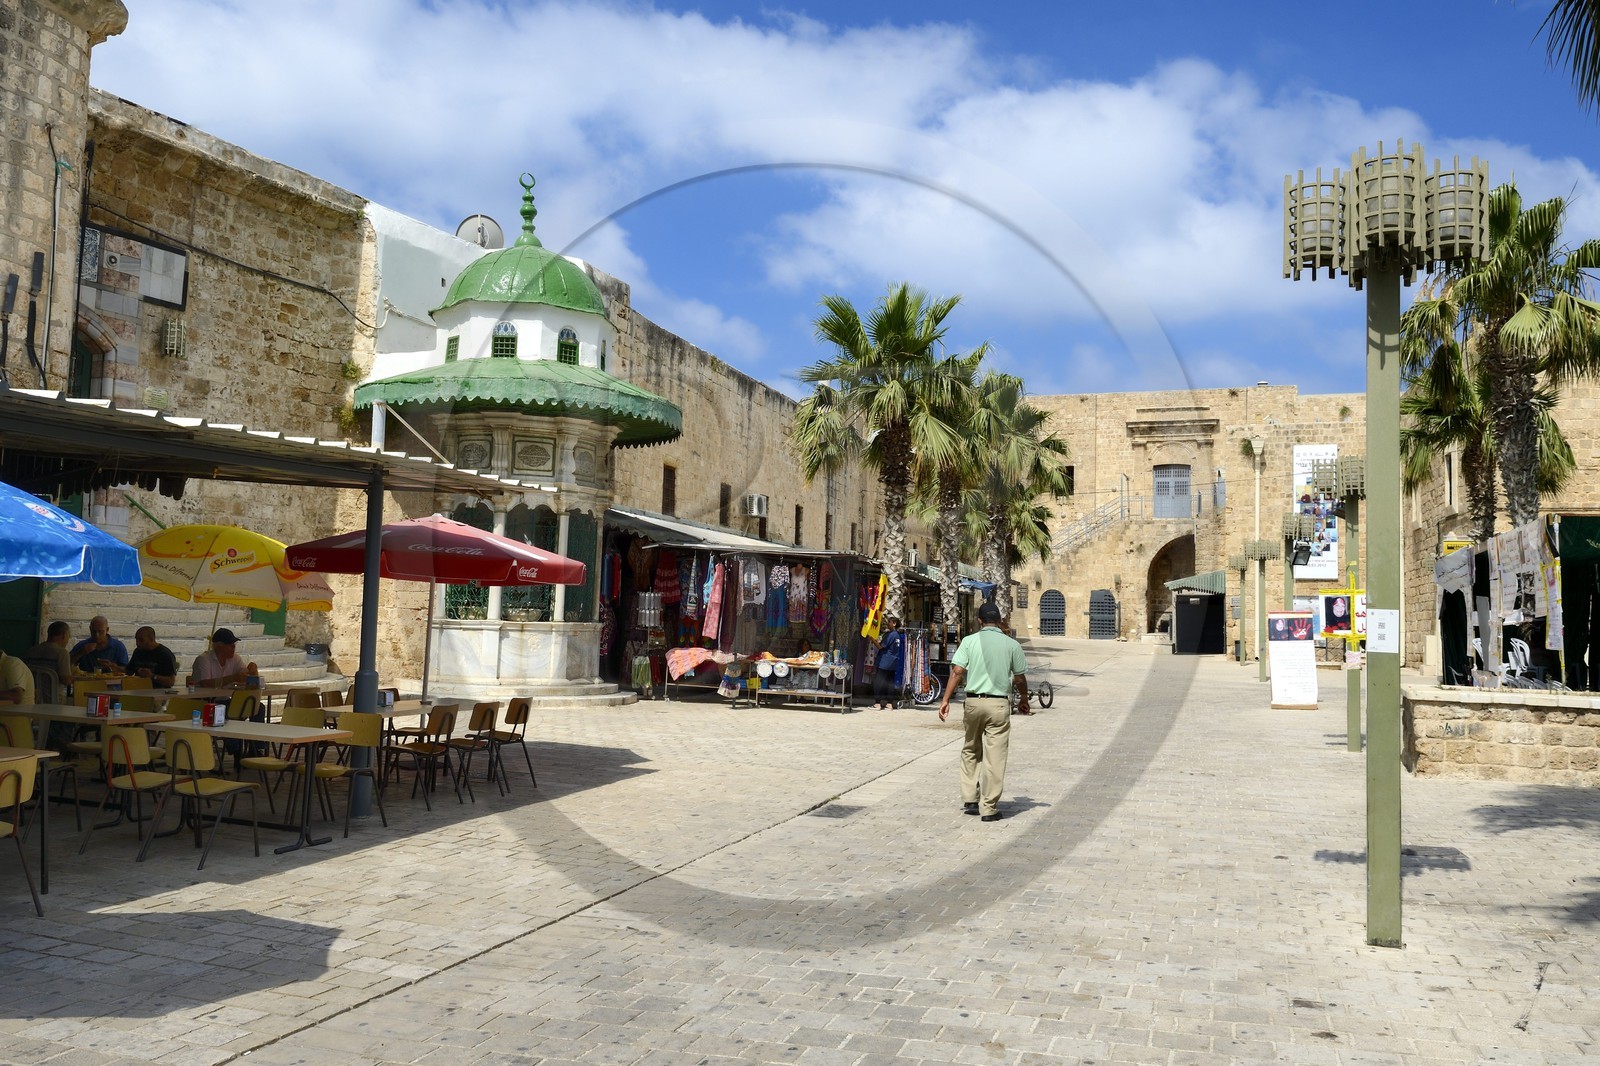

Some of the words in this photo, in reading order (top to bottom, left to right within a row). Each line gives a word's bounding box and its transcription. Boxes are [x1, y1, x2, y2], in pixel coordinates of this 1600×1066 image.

[150, 560, 169, 570] Drink
[168, 566, 194, 581] Different
[518, 566, 538, 578] Coca-Cola
